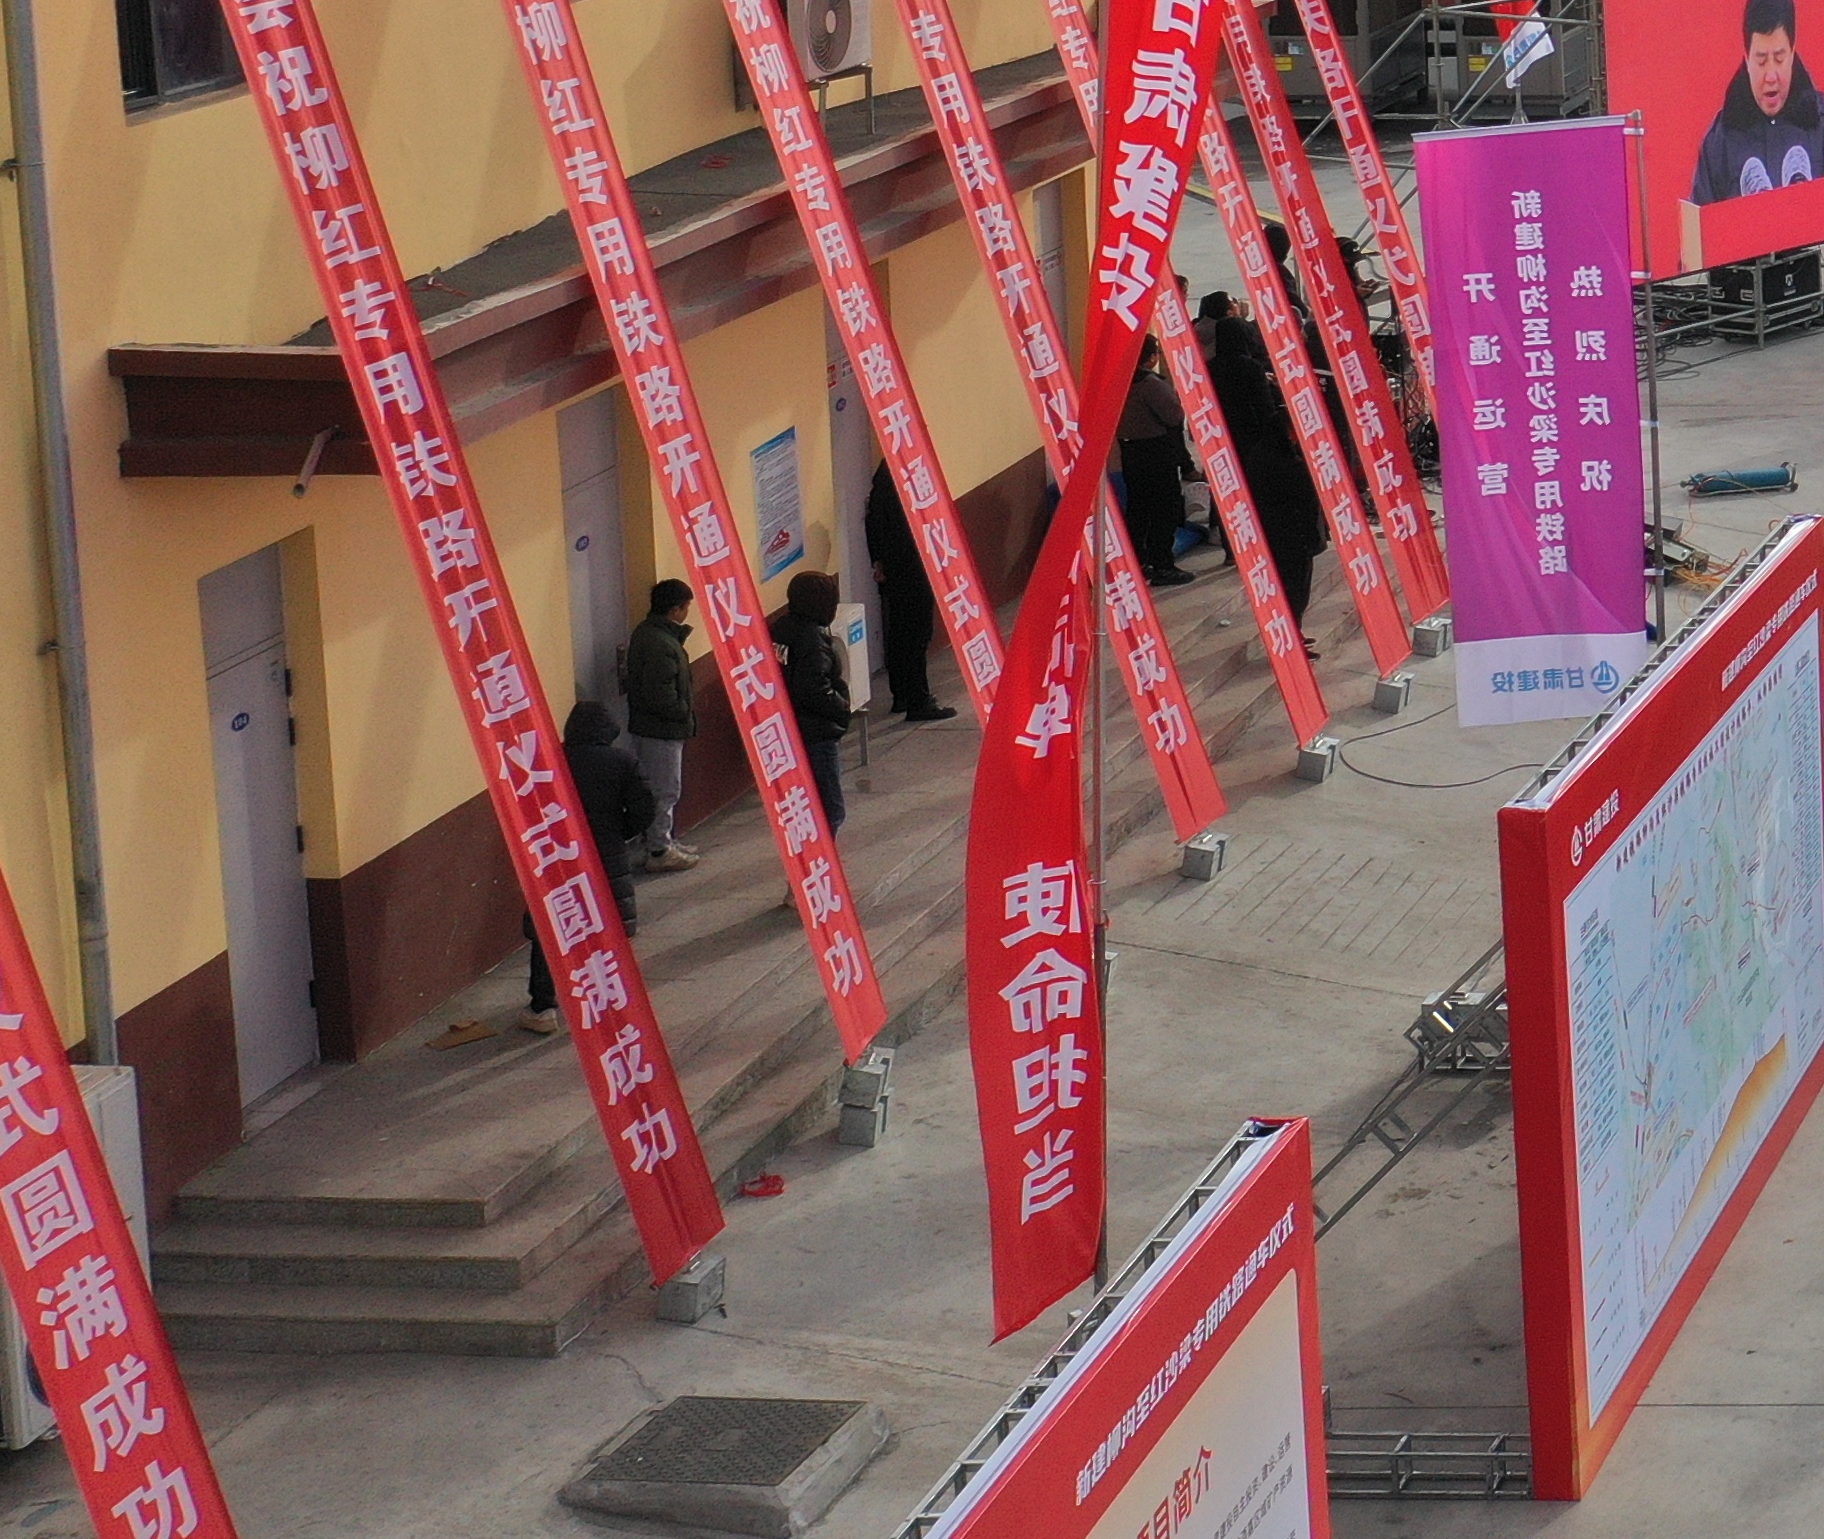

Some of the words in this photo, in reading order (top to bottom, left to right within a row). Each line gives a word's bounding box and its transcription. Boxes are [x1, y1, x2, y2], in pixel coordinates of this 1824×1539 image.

[0, 1010, 198, 1539] 式圆满成功
